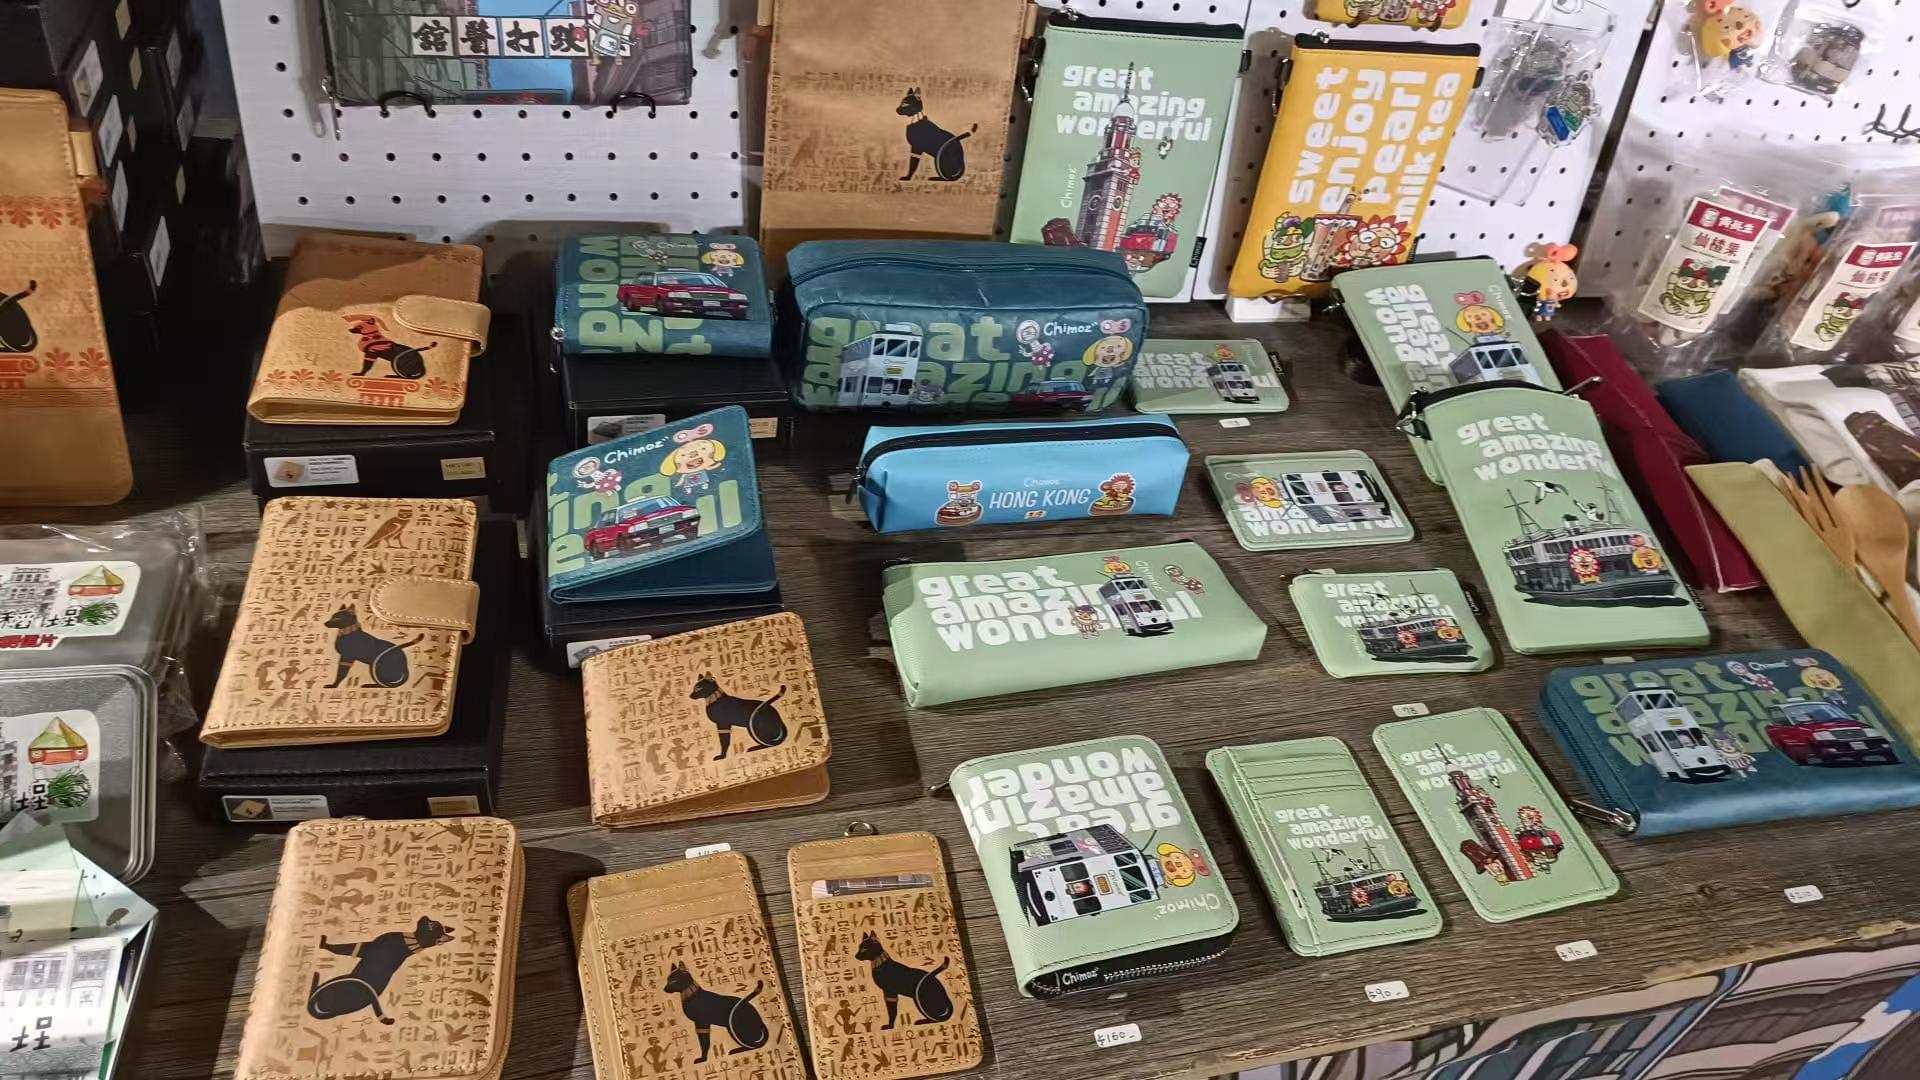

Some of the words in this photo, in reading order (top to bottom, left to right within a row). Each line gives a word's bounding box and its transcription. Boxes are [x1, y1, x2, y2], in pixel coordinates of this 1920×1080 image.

[1417, 73, 1463, 146] tea
[1288, 67, 1349, 205] sweet
[1319, 69, 1387, 213] enjoy
[1360, 71, 1427, 204] pearl
[1456, 412, 1550, 446] great
[1479, 431, 1602, 458] amazing
[989, 490, 1038, 509] HONG
[1042, 488, 1092, 507] KONG
[917, 565, 1074, 599] great
[1275, 803, 1333, 823] great
[1287, 815, 1374, 835] amazing
[1287, 824, 1390, 850] wonderful
